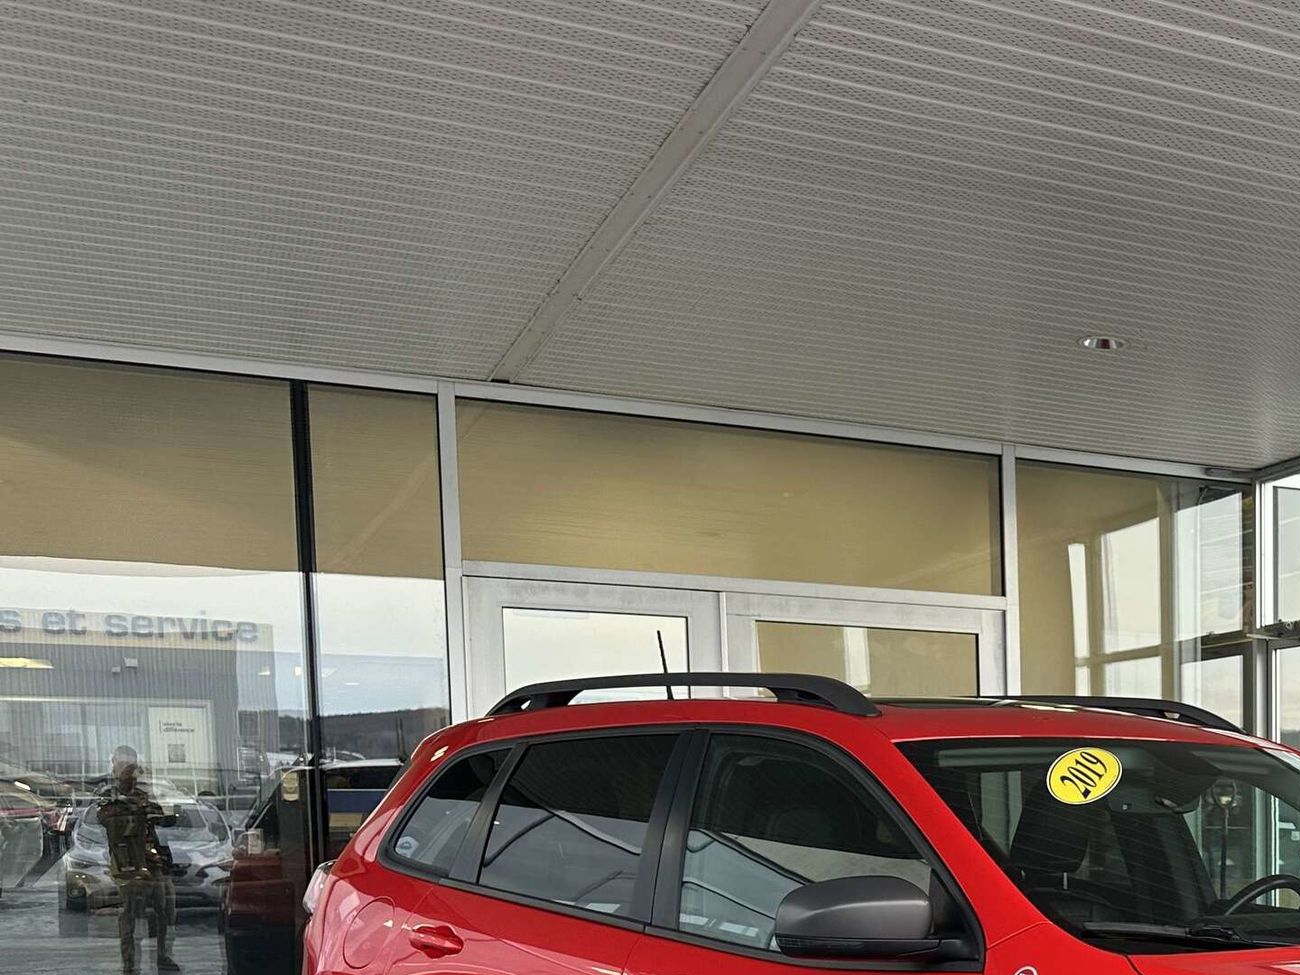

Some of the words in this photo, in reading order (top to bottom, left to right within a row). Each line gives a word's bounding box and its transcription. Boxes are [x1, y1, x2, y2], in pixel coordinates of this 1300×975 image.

[42, 608, 87, 636] et
[105, 610, 259, 642] service
[1060, 751, 1107, 799] 2019
